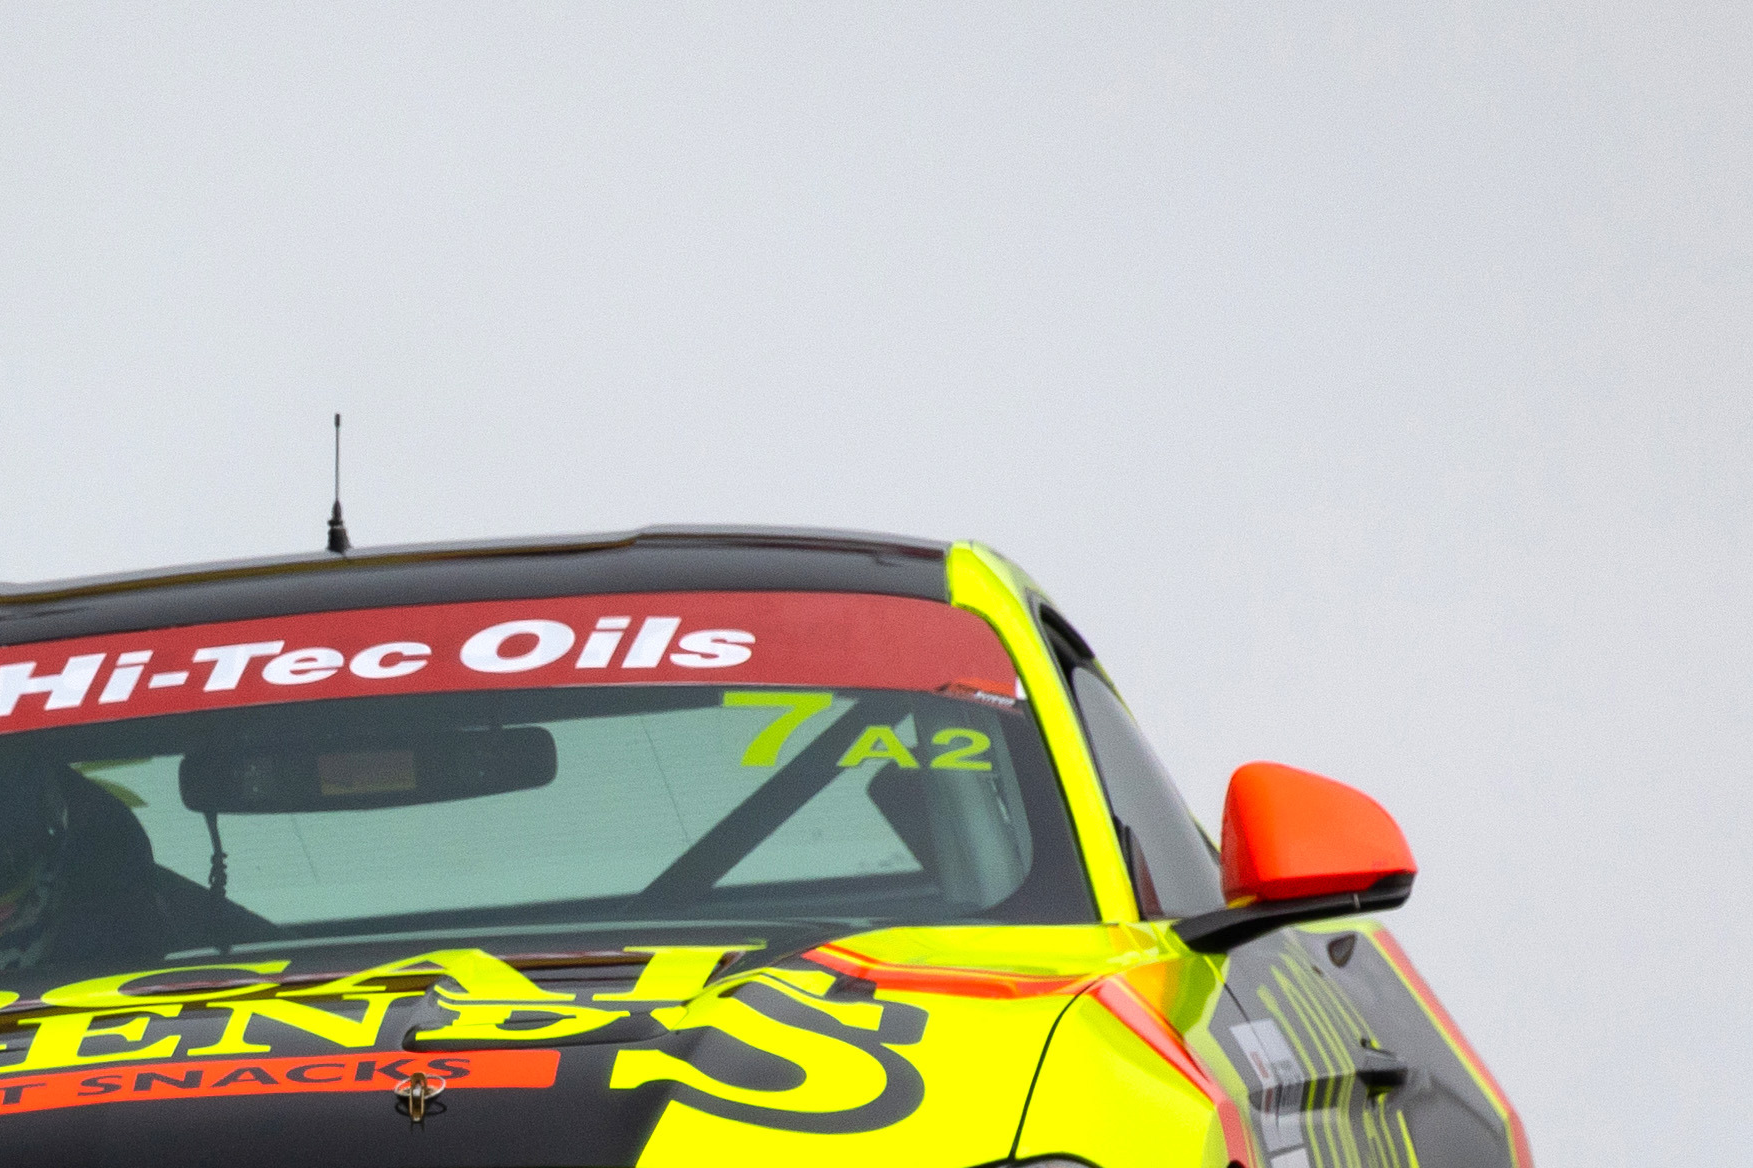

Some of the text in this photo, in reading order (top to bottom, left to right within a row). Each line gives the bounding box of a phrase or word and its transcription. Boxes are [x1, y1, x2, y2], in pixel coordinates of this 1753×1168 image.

[459, 616, 757, 673] Oils
[723, 691, 994, 771] 7 A2
[77, 1056, 473, 1096] SNACKS
